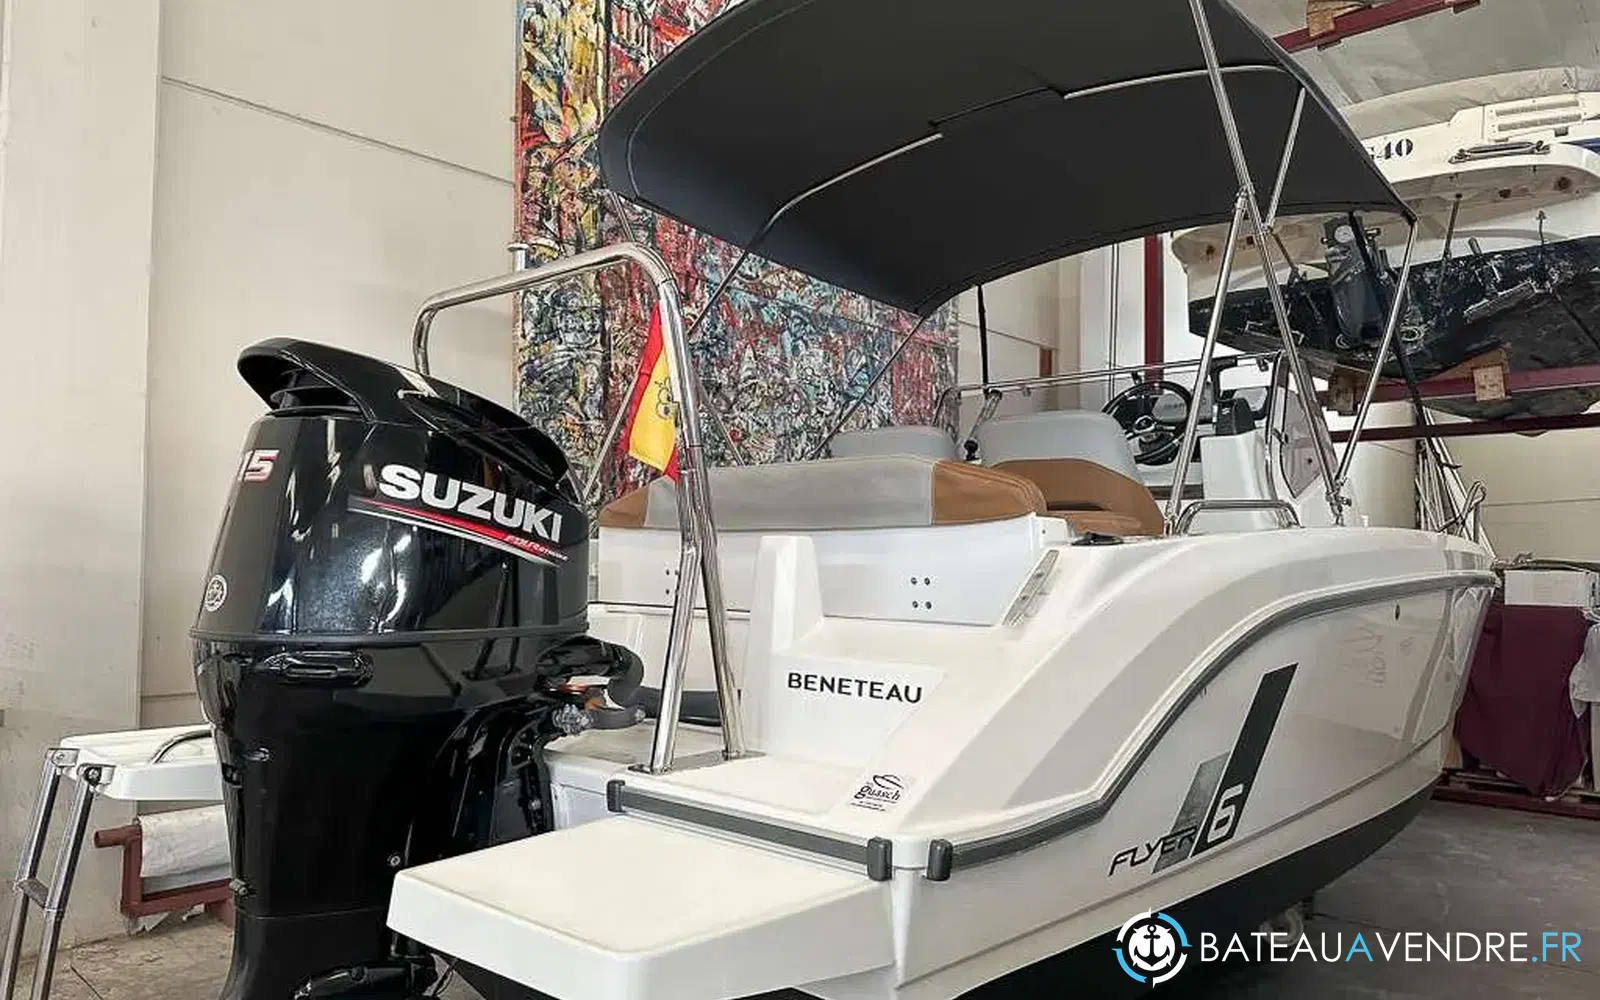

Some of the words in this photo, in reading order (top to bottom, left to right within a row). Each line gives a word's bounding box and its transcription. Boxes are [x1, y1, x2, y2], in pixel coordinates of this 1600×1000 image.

[379, 464, 562, 543] SUZUKI
[788, 673, 922, 703] BENETEAU
[1108, 825, 1198, 877] FLYER
[1207, 783, 1244, 844] 6
